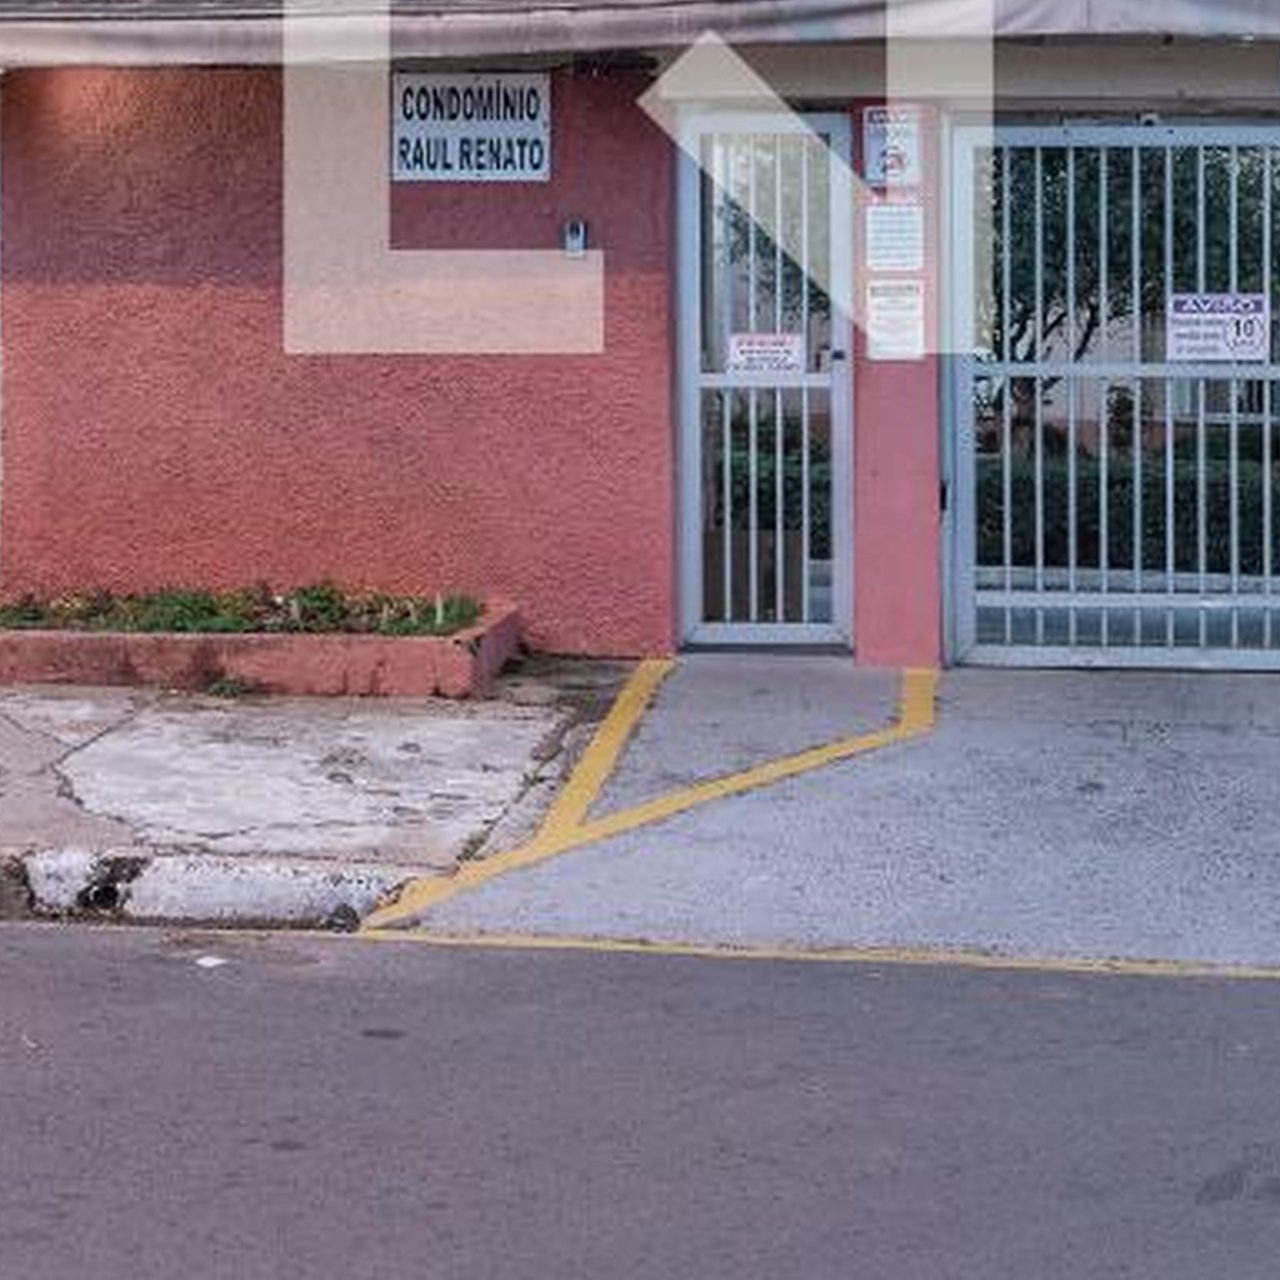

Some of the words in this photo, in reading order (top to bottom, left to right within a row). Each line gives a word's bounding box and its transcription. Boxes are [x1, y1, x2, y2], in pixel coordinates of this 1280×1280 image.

[402, 80, 541, 121] CONDOMÍNIO
[400, 138, 452, 170] RAUL
[459, 138, 545, 170] RENATO
[1235, 320, 1254, 337] 10
